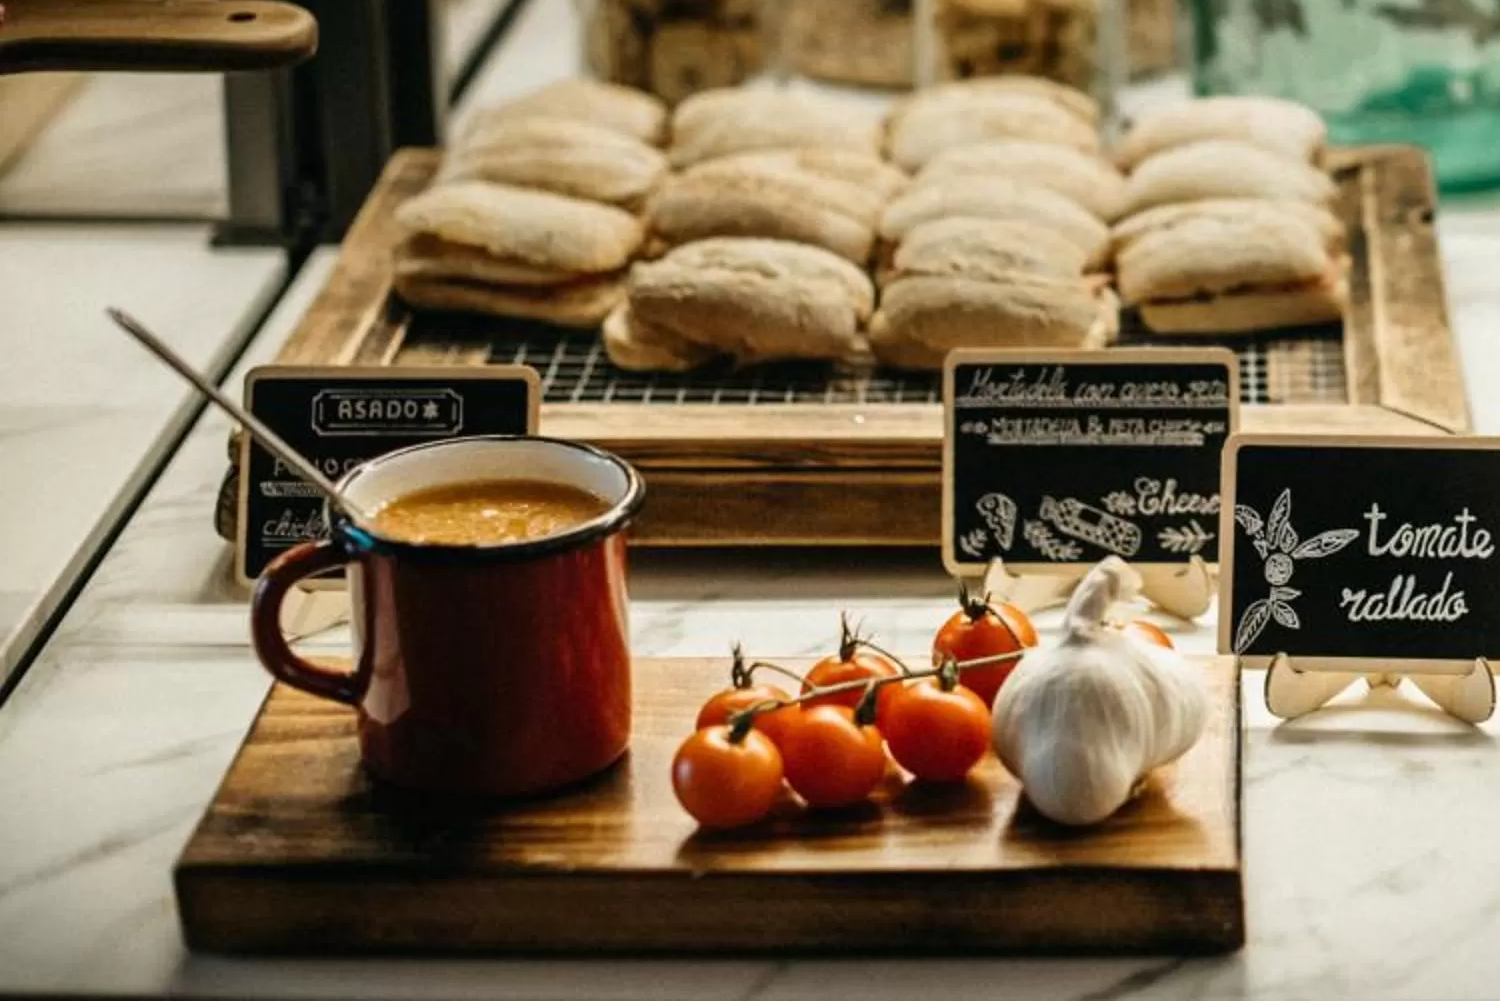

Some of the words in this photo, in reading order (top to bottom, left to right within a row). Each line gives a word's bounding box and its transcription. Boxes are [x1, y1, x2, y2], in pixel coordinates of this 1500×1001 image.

[338, 399, 419, 420] ASADO
[1134, 477, 1221, 516] Cheese
[1363, 502, 1495, 559] tomate
[1340, 571, 1469, 622] rallado
